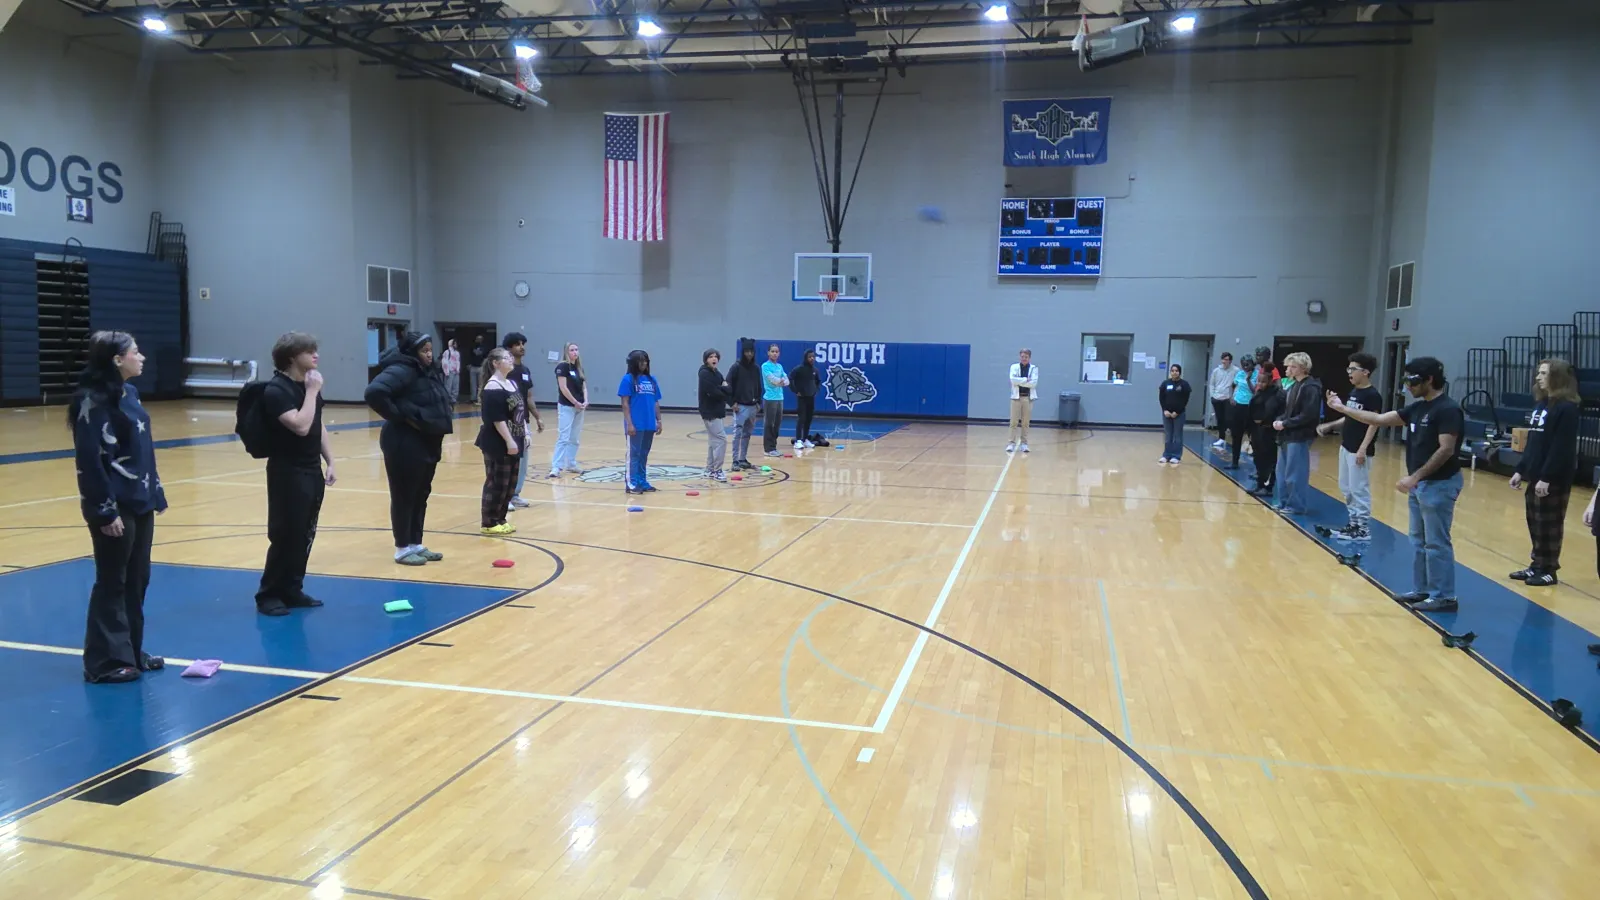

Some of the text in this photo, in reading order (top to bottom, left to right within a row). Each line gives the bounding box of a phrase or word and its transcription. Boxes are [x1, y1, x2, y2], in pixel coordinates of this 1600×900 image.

[1014, 149, 1095, 160] South High Alumni
[1002, 201, 1025, 210] HOME
[1077, 200, 1104, 209] GUEST
[815, 343, 885, 364] SOUTH
